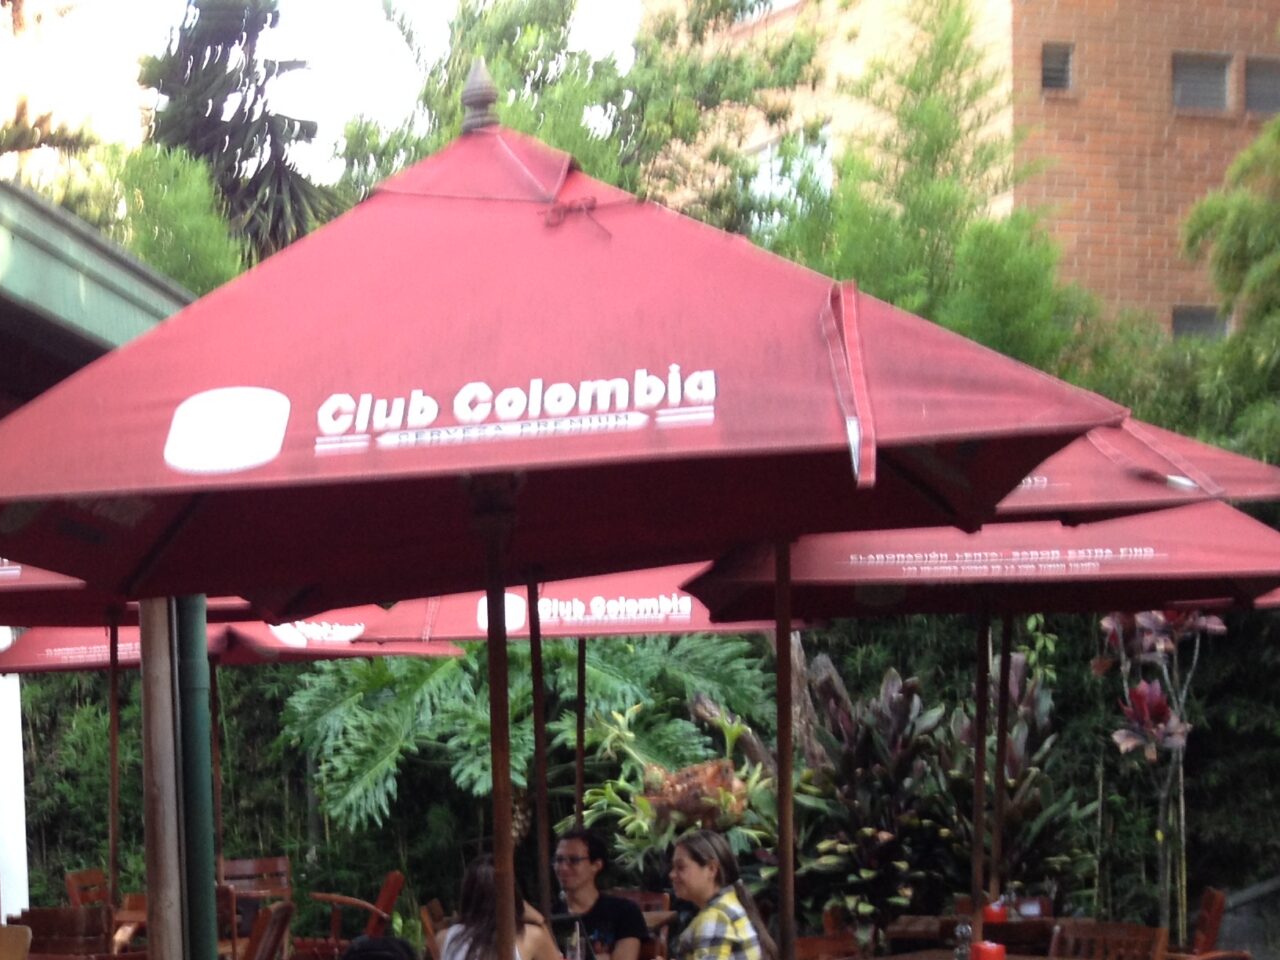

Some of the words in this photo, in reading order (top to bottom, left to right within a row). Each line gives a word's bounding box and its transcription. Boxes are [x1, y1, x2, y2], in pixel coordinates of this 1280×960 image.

[316, 388, 439, 435] Club
[452, 363, 717, 422] Colombia
[519, 412, 631, 431] PREMIUM
[538, 598, 586, 619] Club
[590, 593, 692, 618] Colombia
